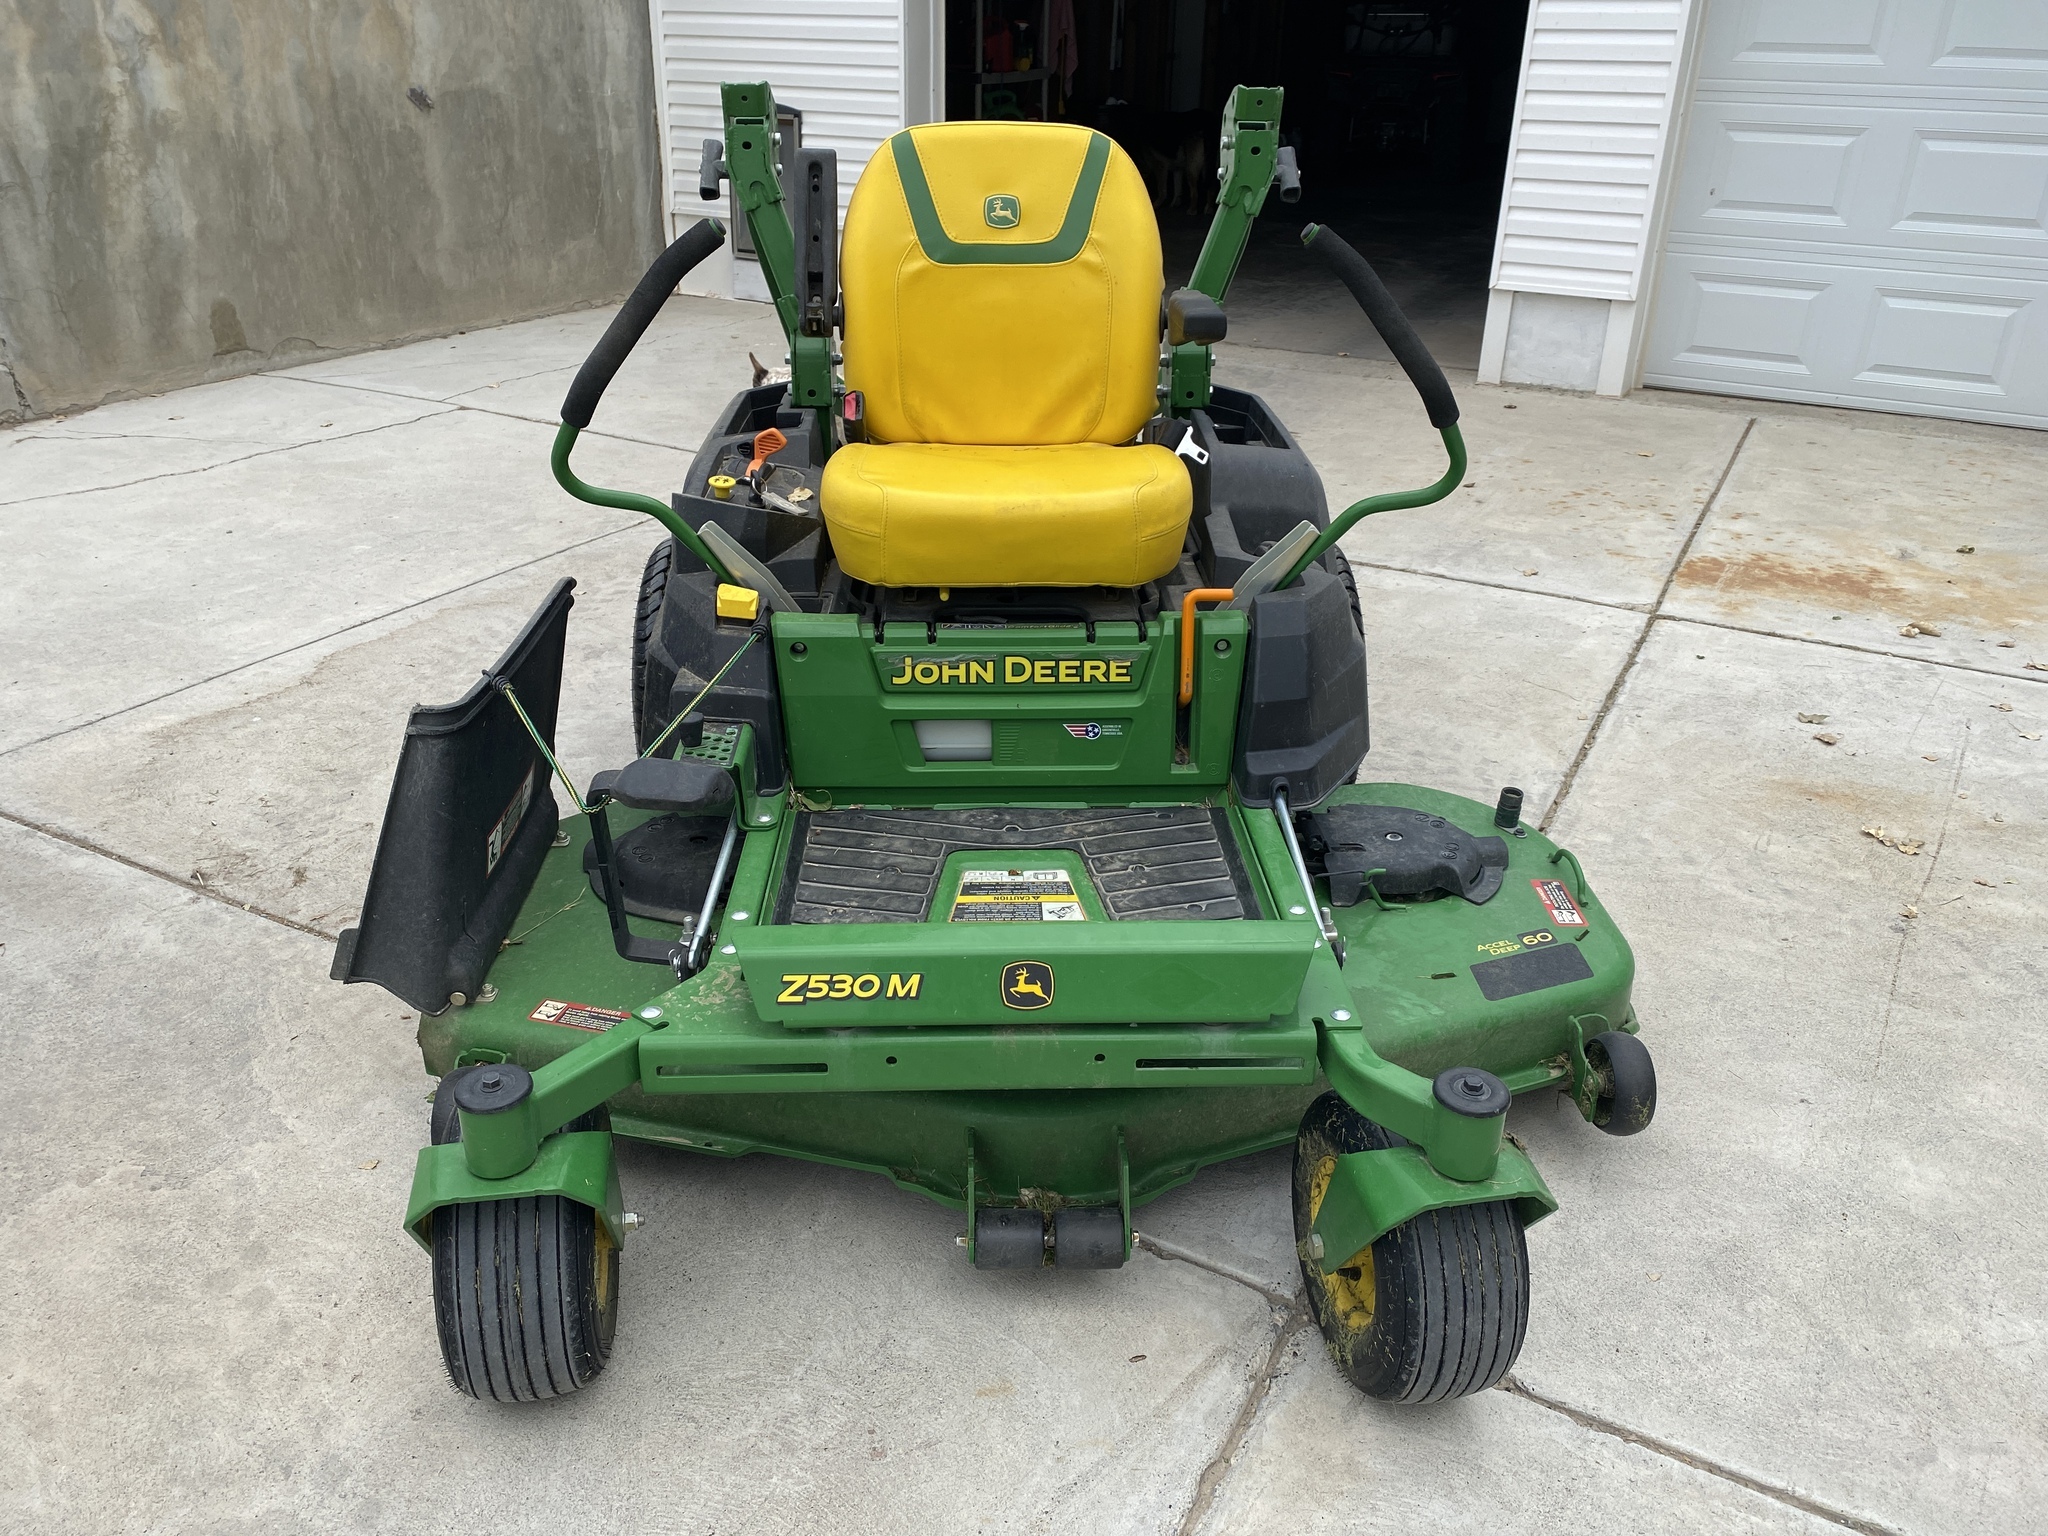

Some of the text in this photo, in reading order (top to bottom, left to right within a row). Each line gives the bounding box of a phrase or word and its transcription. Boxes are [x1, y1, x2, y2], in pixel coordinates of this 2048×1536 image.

[891, 655, 1132, 685] JOHN DEERE
[1522, 932, 1553, 946] 60
[1477, 940, 1514, 952] ACCEL
[1491, 944, 1521, 956] DEEP
[776, 973, 925, 1005] Z530 M
[591, 1007, 622, 1015] DANGER
